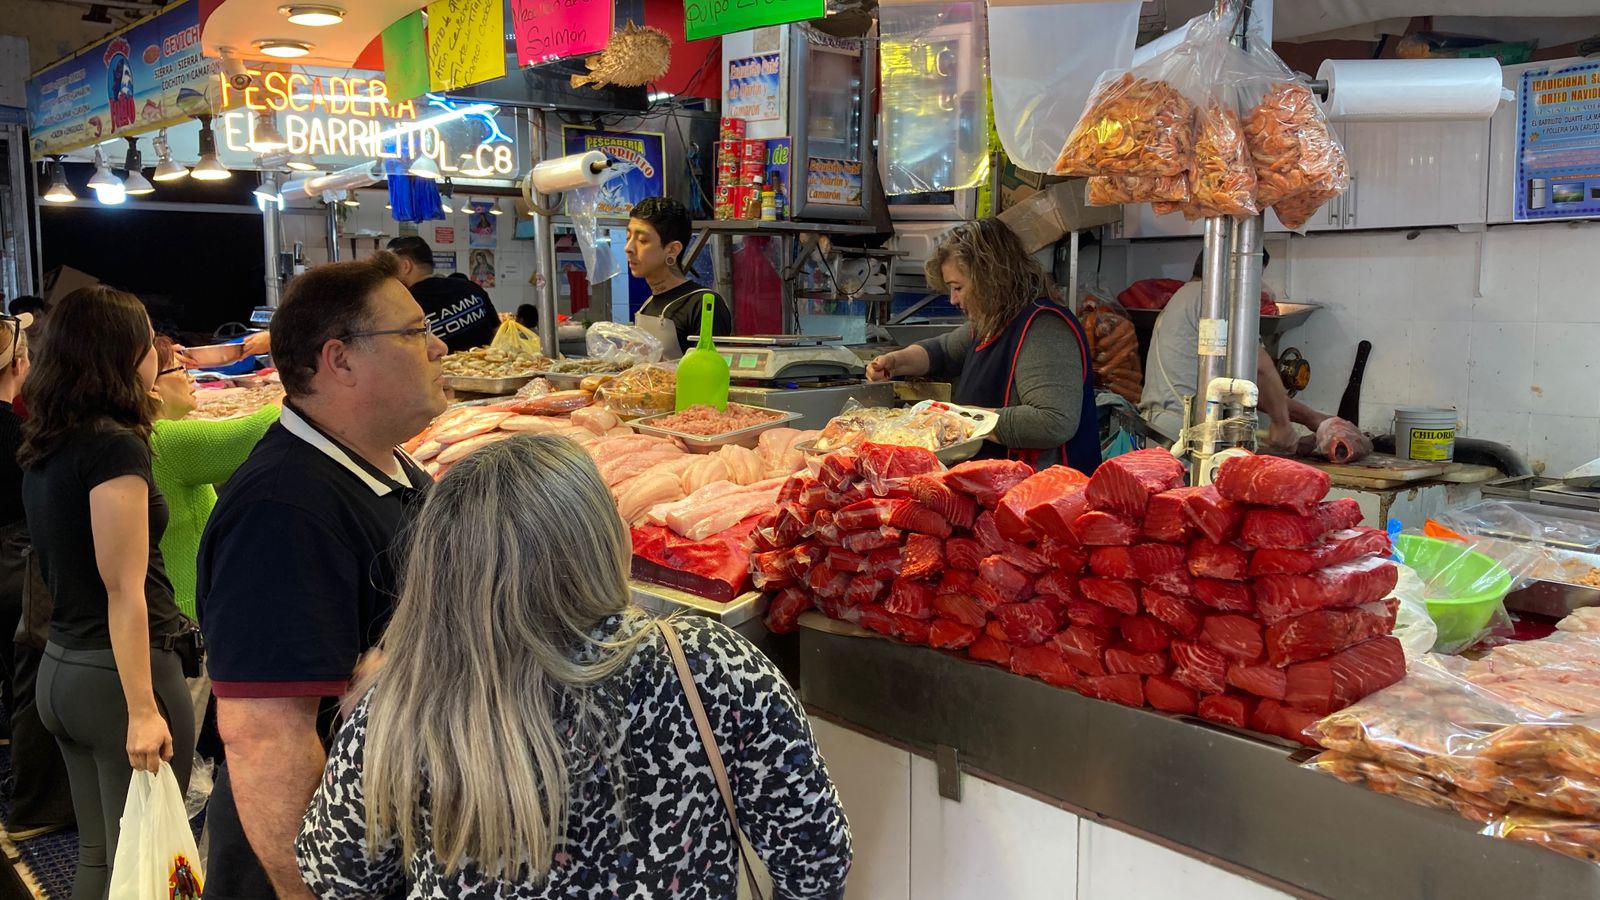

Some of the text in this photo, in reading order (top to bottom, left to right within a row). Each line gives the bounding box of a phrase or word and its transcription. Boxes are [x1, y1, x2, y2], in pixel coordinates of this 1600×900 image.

[686, 0, 729, 30] Pulpo
[163, 26, 202, 57] CEVICH
[526, 22, 586, 56] Salmón
[154, 66, 173, 79] SIERRA
[178, 55, 198, 70] SIERRA
[161, 73, 185, 91] COCHITO
[225, 111, 440, 160] EL BARRILITO
[586, 136, 645, 155] PESCADERIA
[772, 144, 789, 165] de
